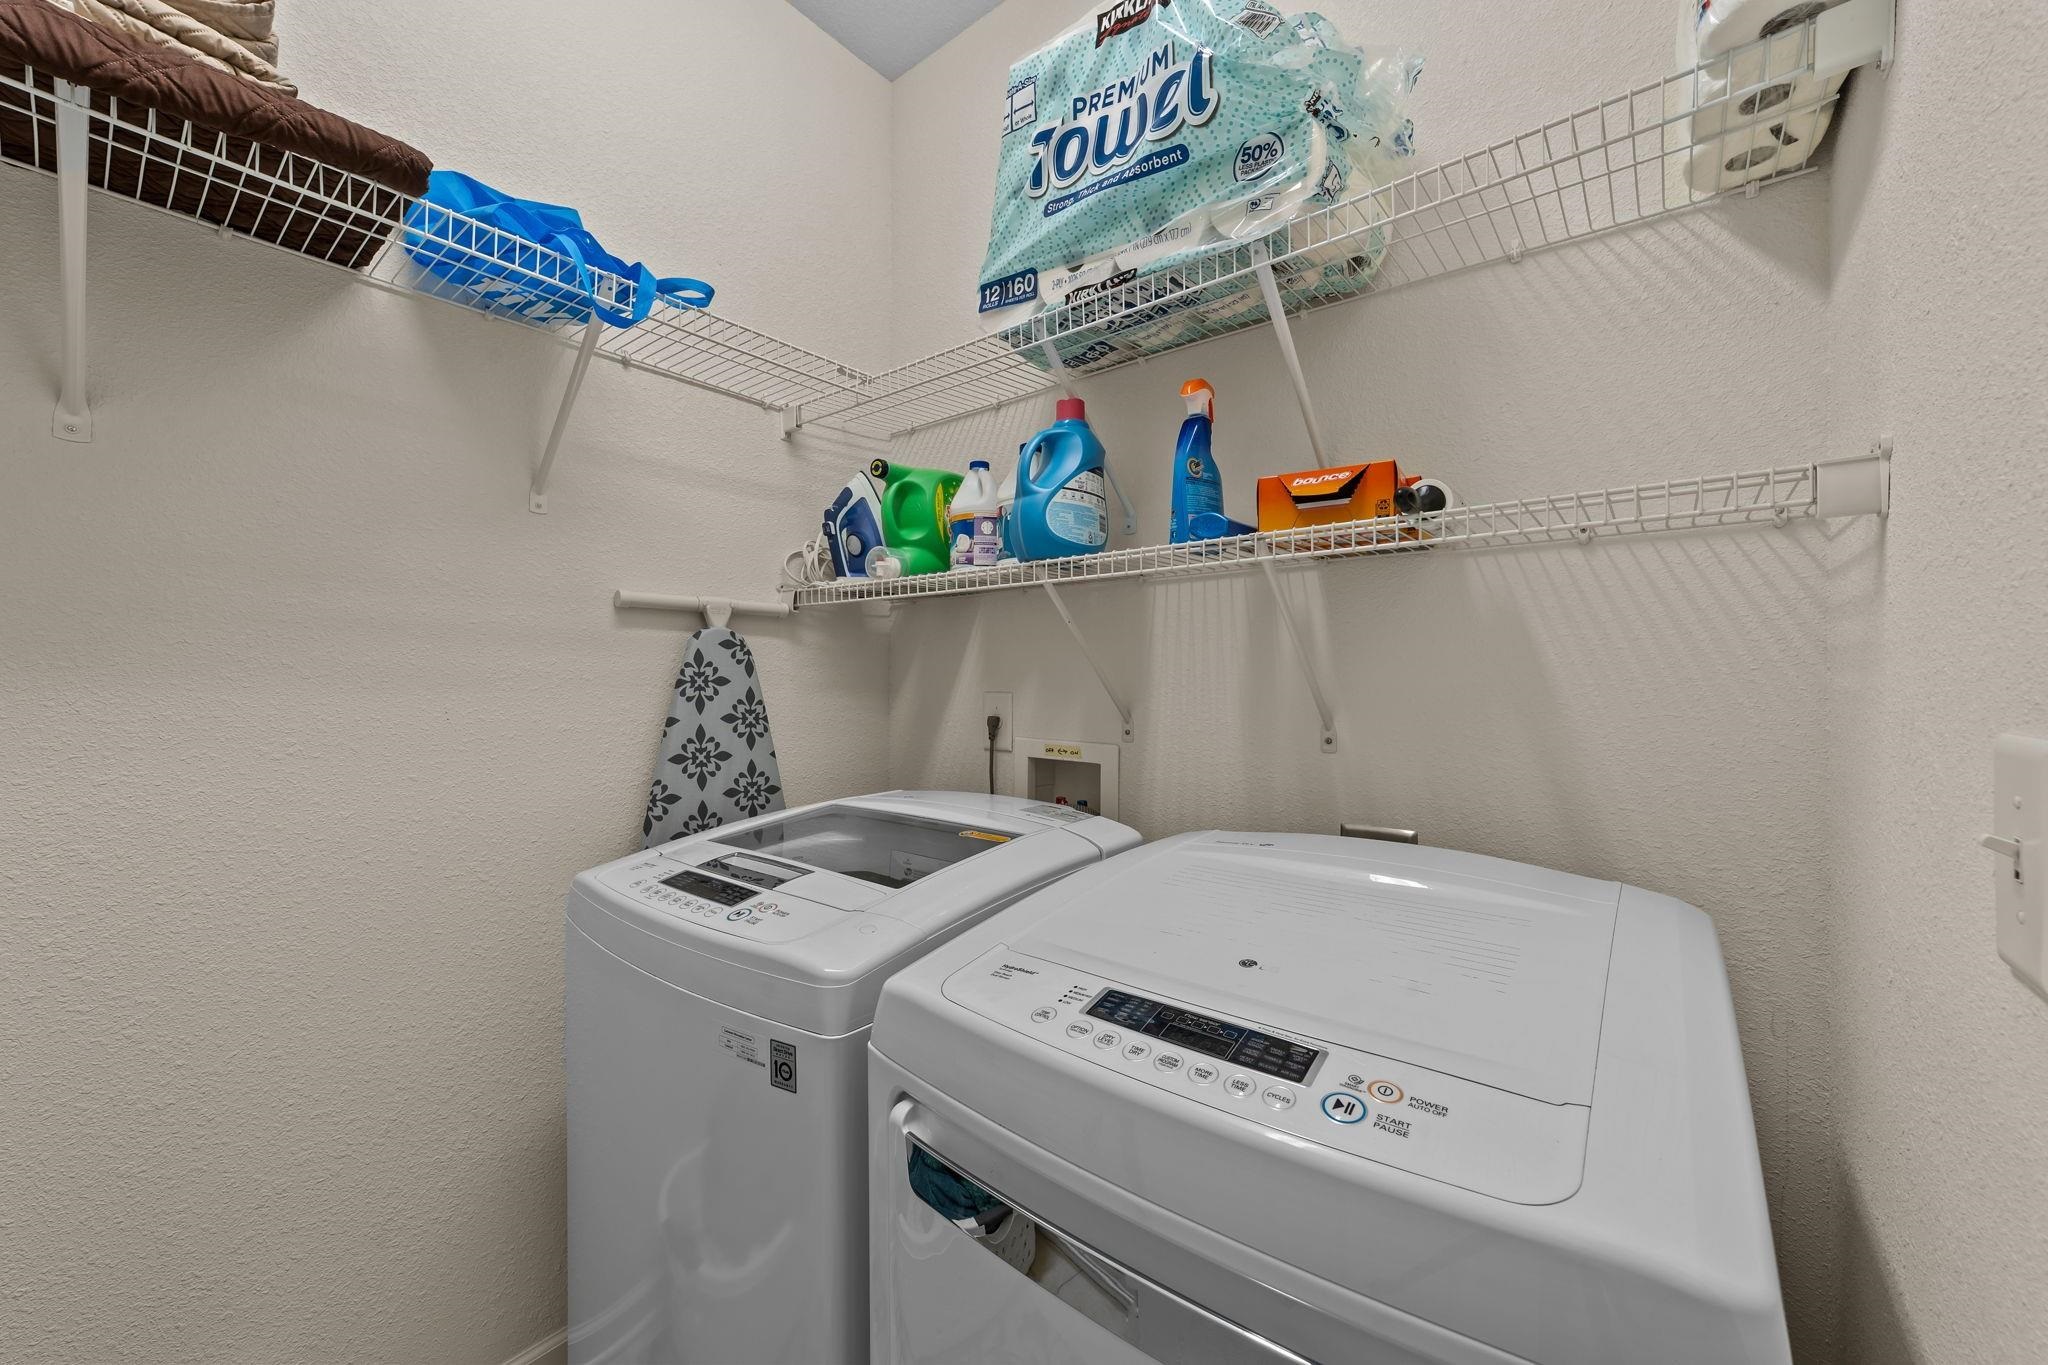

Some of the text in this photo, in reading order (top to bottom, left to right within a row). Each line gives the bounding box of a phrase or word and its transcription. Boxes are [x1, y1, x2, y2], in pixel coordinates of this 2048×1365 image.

[1073, 44, 1169, 120] PREMIUM
[1028, 50, 1212, 192] Towel
[1240, 141, 1278, 163] 50%
[1079, 182, 1100, 198] Thick
[1101, 173, 1121, 187] and
[1121, 149, 1183, 180] Absorbent
[984, 273, 1035, 304] 12 160
[982, 300, 999, 309] ROLLS
[1293, 471, 1351, 486] bounce
[1070, 1024, 1089, 1034] OPTION
[1128, 1049, 1141, 1057] DRY
[1132, 1045, 1146, 1053] TIME
[774, 1060, 792, 1081] 10
[1194, 1067, 1214, 1077] MORE
[1194, 1071, 1209, 1080] TIME
[1230, 1083, 1245, 1092] TIME
[1232, 1079, 1249, 1087] LESS
[1266, 1091, 1291, 1104] CYCLES
[1409, 1096, 1449, 1113] POWER
[1407, 1102, 1448, 1118] AUTO OFF
[1375, 1113, 1412, 1129] START
[1373, 1121, 1410, 1139] PAUSE
